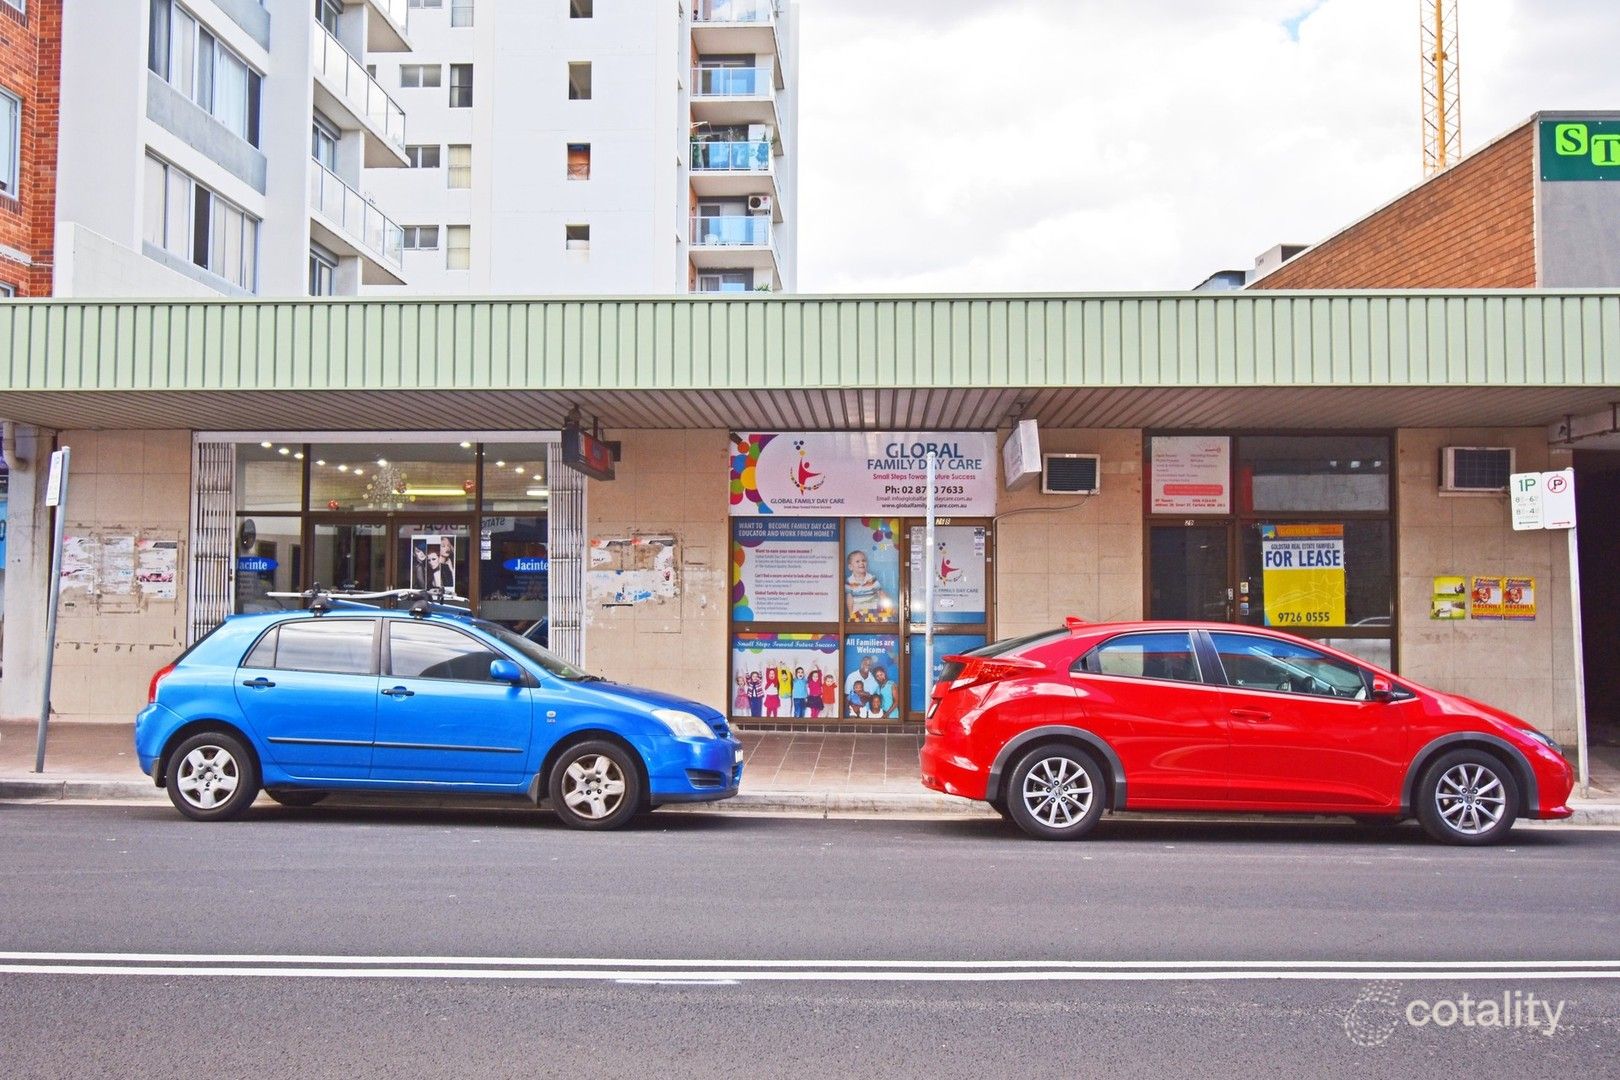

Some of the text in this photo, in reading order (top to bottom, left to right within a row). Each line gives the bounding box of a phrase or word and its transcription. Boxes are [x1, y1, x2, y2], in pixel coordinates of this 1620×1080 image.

[886, 442, 964, 459] GLOBAL
[867, 459, 982, 470] FAMILY DY CARE
[891, 473, 907, 481] Steps
[885, 485, 964, 494] Ph: 02 870 7633
[1519, 478, 1536, 491] 1P
[1265, 550, 1341, 567] FOR LEASE
[514, 559, 548, 571] Jacinte
[1278, 612, 1330, 622] 9726 0555
[755, 640, 771, 648] Steps
[846, 638, 855, 646] All
[856, 638, 883, 646] Families
